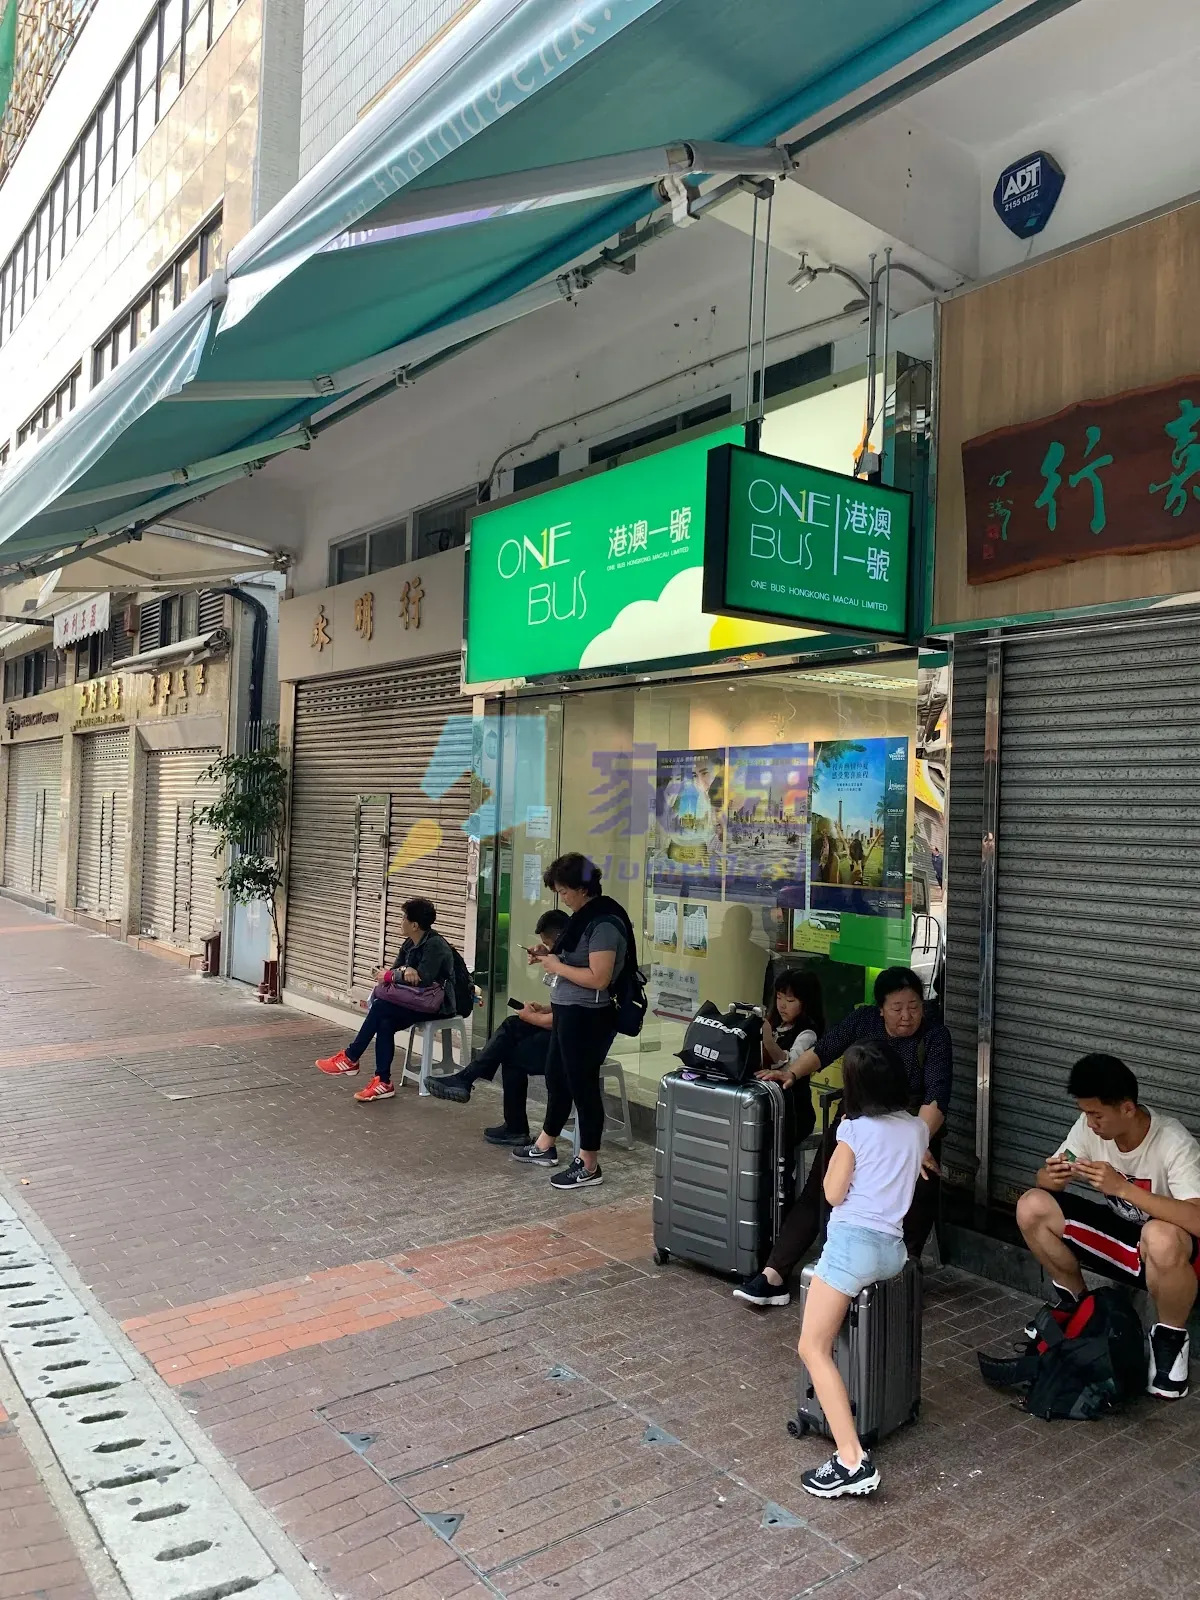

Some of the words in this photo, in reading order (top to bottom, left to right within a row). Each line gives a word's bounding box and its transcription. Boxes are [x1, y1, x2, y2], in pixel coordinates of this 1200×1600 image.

[1003, 160, 1040, 201] ADT
[1004, 198, 1021, 211] 2155
[1022, 189, 1039, 203] 0222
[607, 506, 691, 559] 港澳一號
[843, 498, 891, 540] 港澳
[750, 523, 812, 570] BUS
[843, 546, 889, 582] 一號
[528, 569, 587, 626] BUS
[750, 579, 768, 590] ONE
[770, 583, 786, 593] BUS
[788, 587, 830, 601] HONGKONG
[832, 594, 859, 607] MACAU
[861, 600, 888, 612] LIMITED
